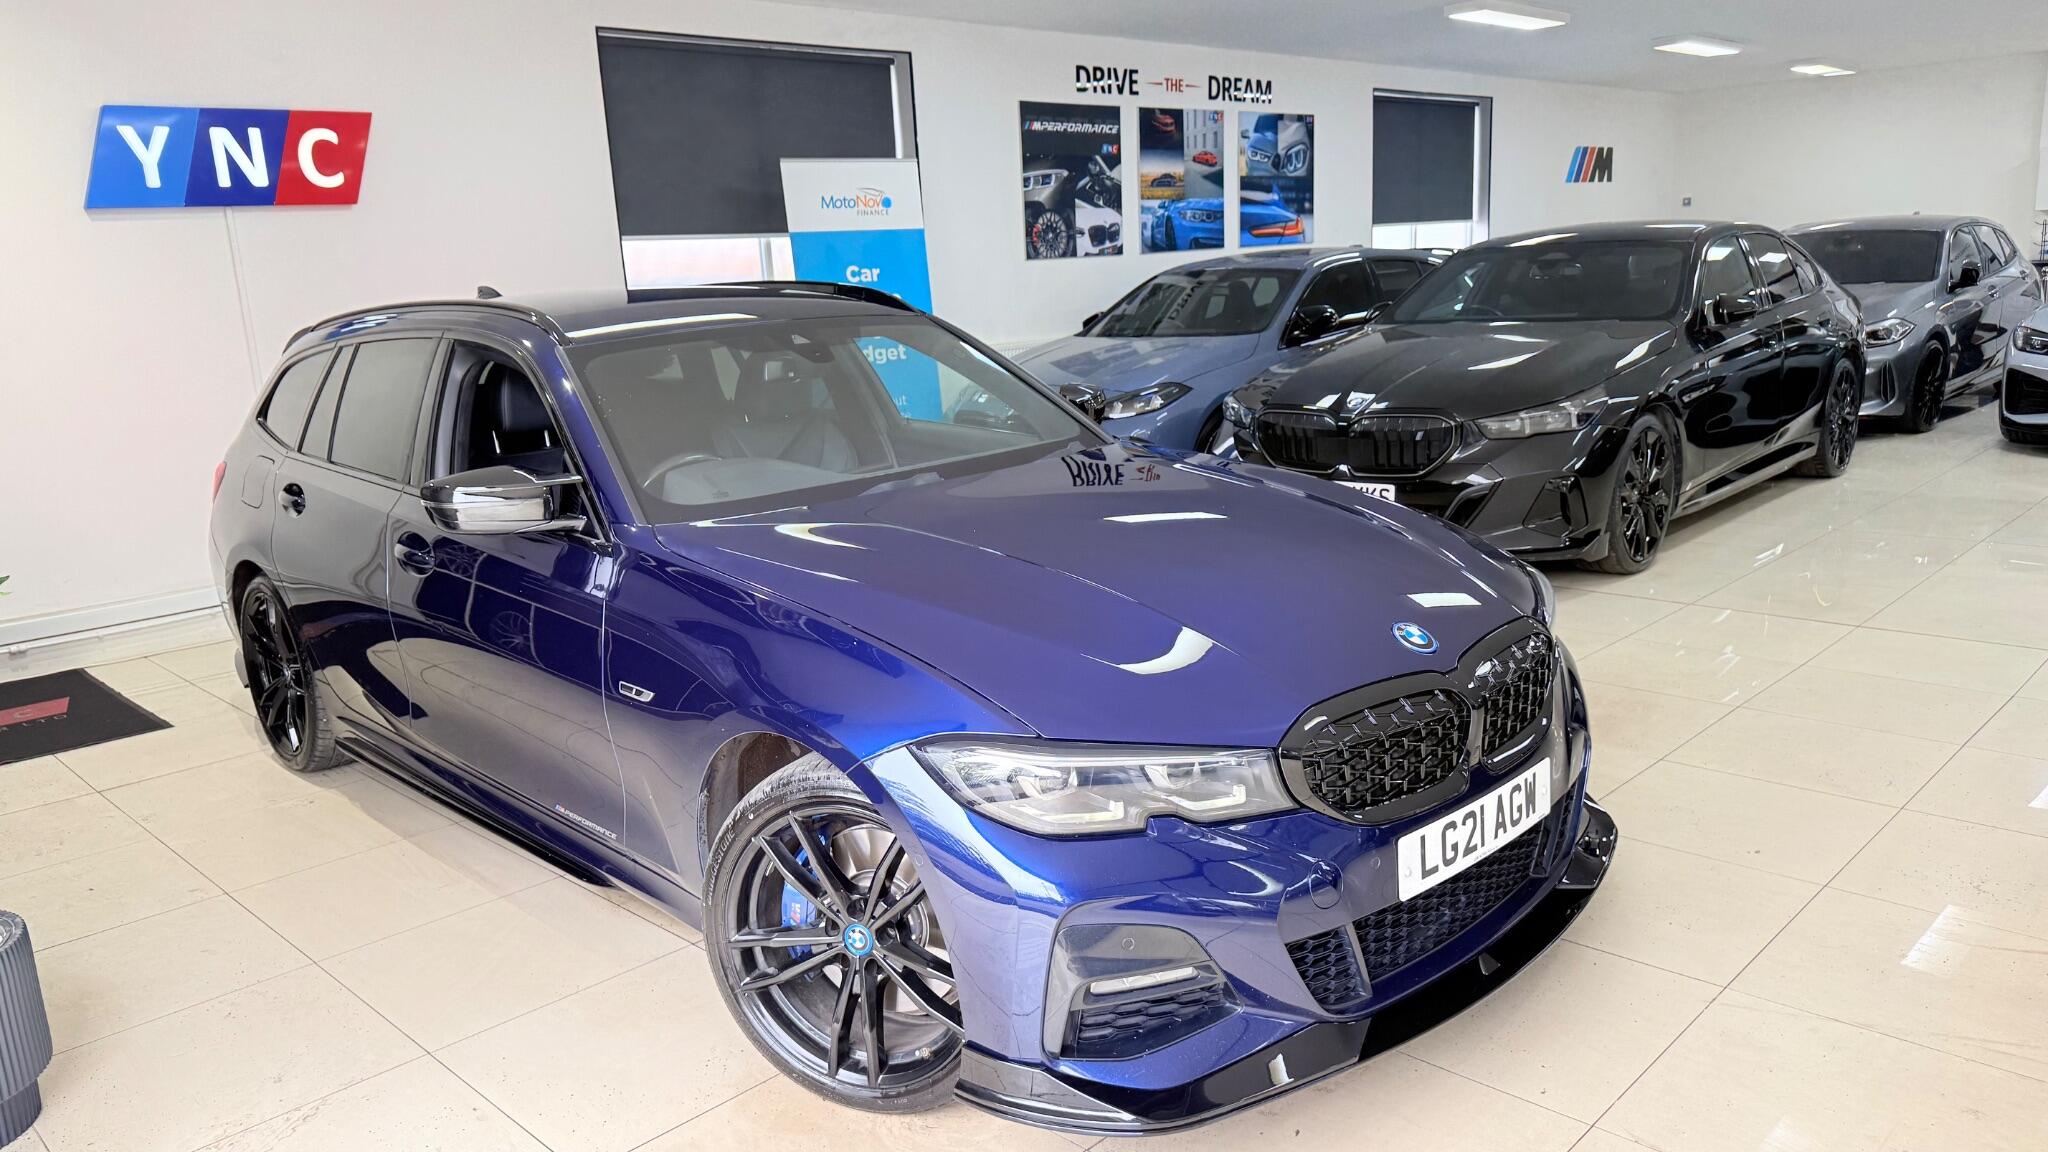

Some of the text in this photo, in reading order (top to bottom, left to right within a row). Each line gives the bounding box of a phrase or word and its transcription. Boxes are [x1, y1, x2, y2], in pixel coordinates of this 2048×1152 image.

[1076, 65, 1272, 104] DRIVE THE DREAM
[116, 125, 345, 188] YNC
[821, 194, 892, 209] MotoNovo
[856, 208, 889, 217] FINANCE
[846, 265, 880, 283] Car
[1420, 772, 1537, 880] LG21 AGW
